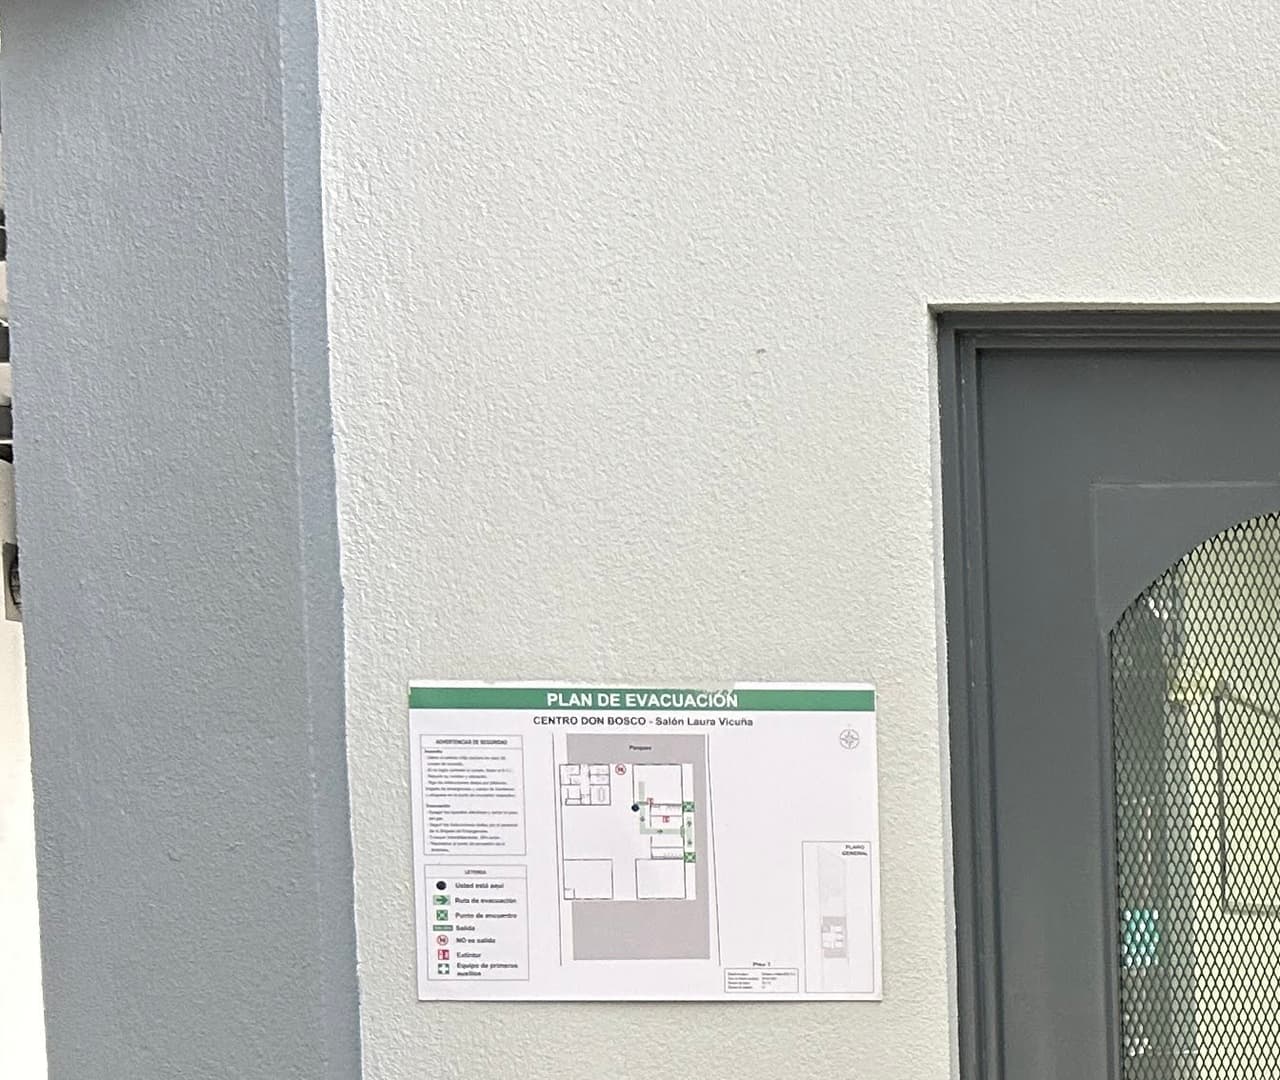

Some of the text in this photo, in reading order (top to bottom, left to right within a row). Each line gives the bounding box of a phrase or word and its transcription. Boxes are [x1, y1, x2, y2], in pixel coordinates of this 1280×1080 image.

[547, 690, 738, 708] PLAN DE EVACUACIÓN
[533, 716, 578, 726] CENTRO
[581, 717, 604, 726] DON
[607, 717, 646, 726] BOSCO
[655, 717, 684, 726] Salón
[687, 717, 716, 727] Laura
[718, 717, 753, 727] Vicuña
[490, 883, 504, 891] aquí
